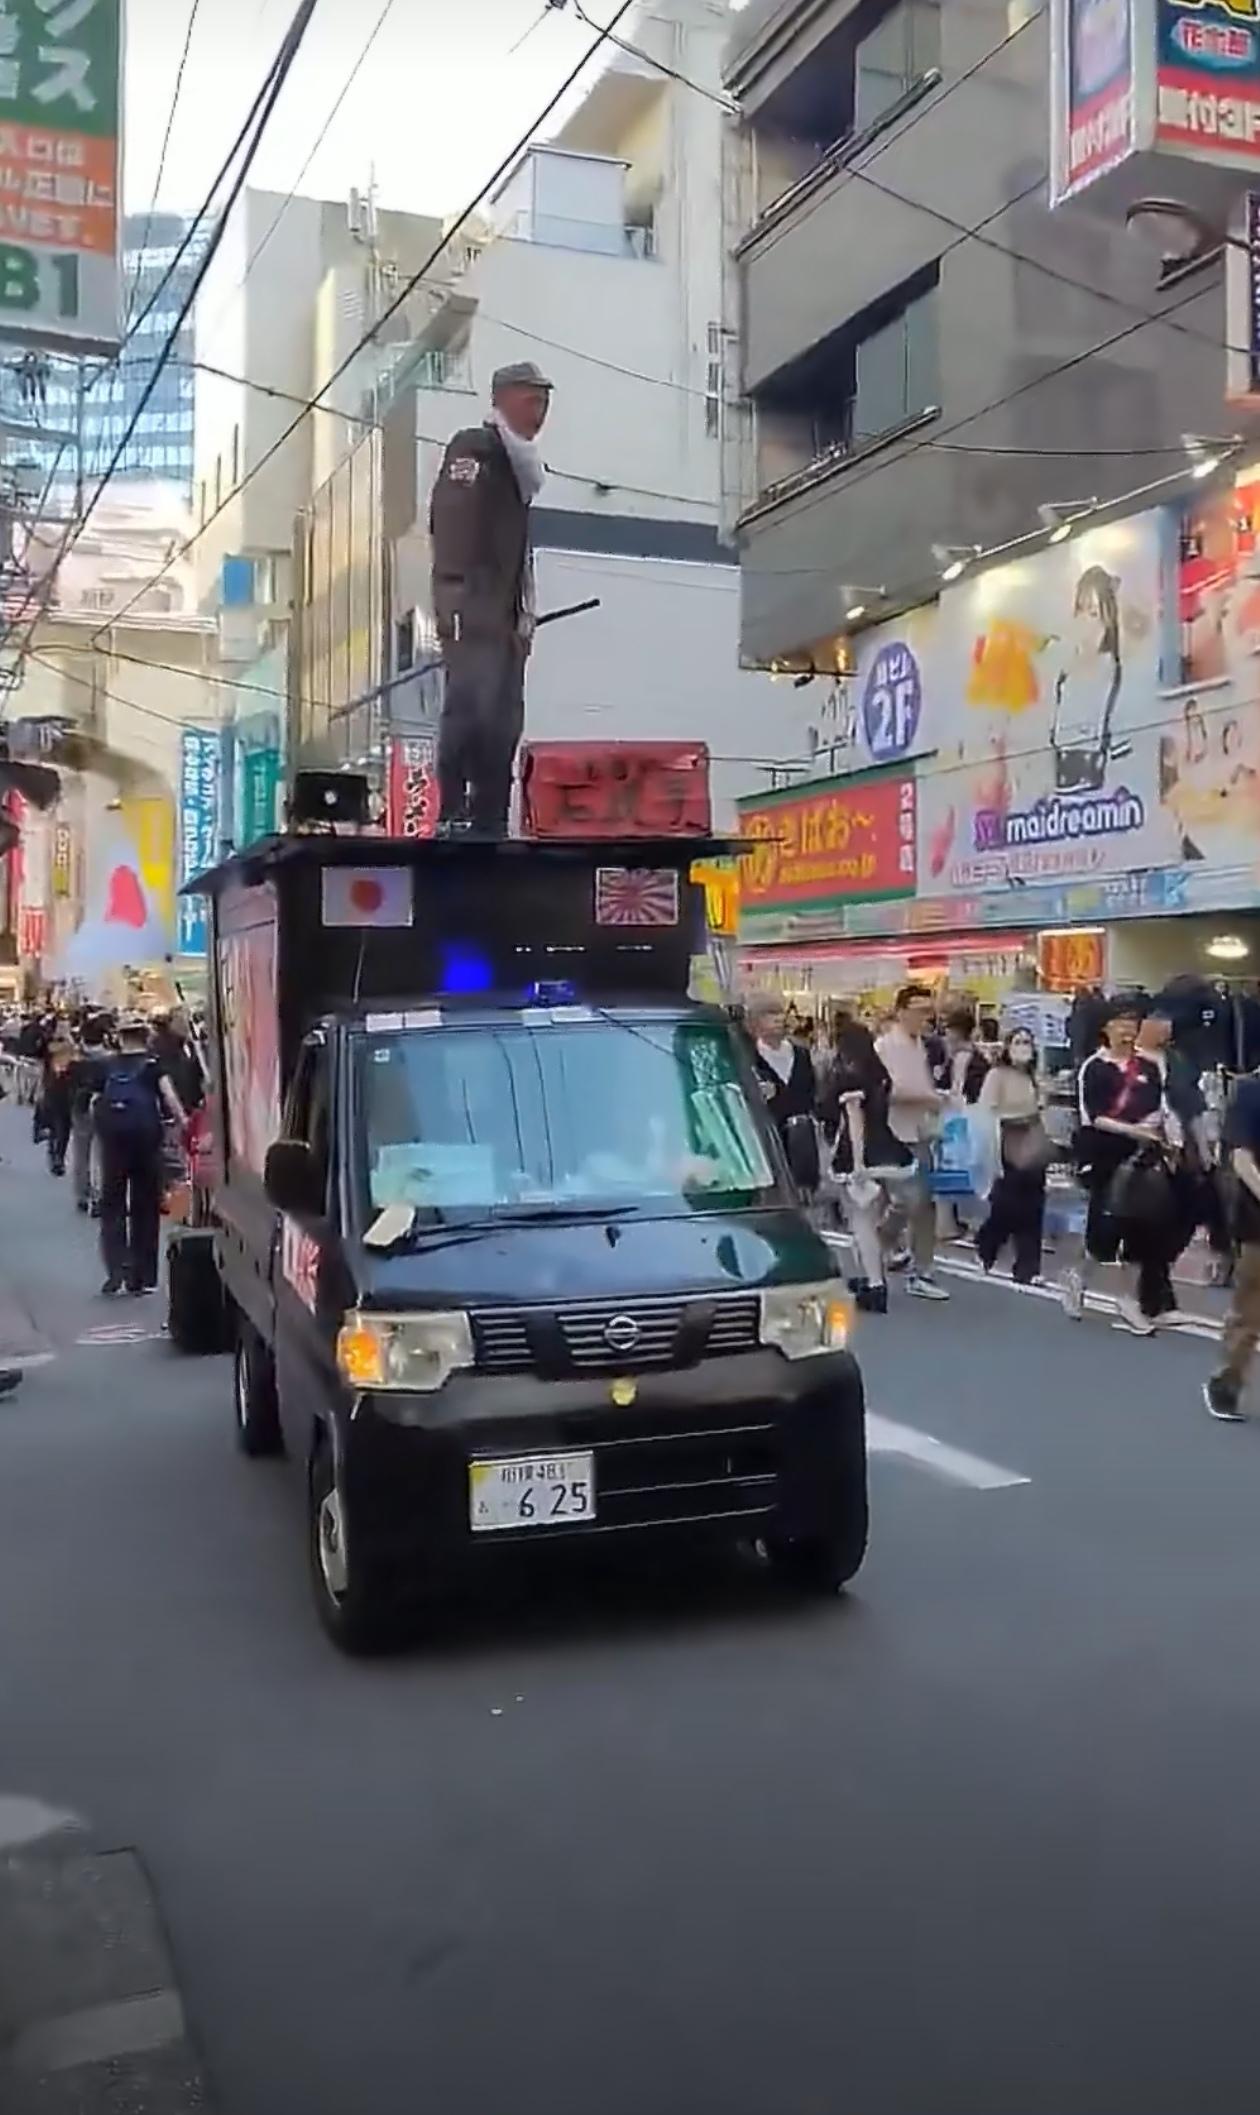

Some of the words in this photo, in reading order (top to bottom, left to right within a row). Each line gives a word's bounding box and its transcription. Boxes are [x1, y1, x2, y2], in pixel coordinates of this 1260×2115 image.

[0, 244, 79, 318] B1
[872, 680, 914, 752] 2F
[1004, 794, 1144, 846] maidreamin
